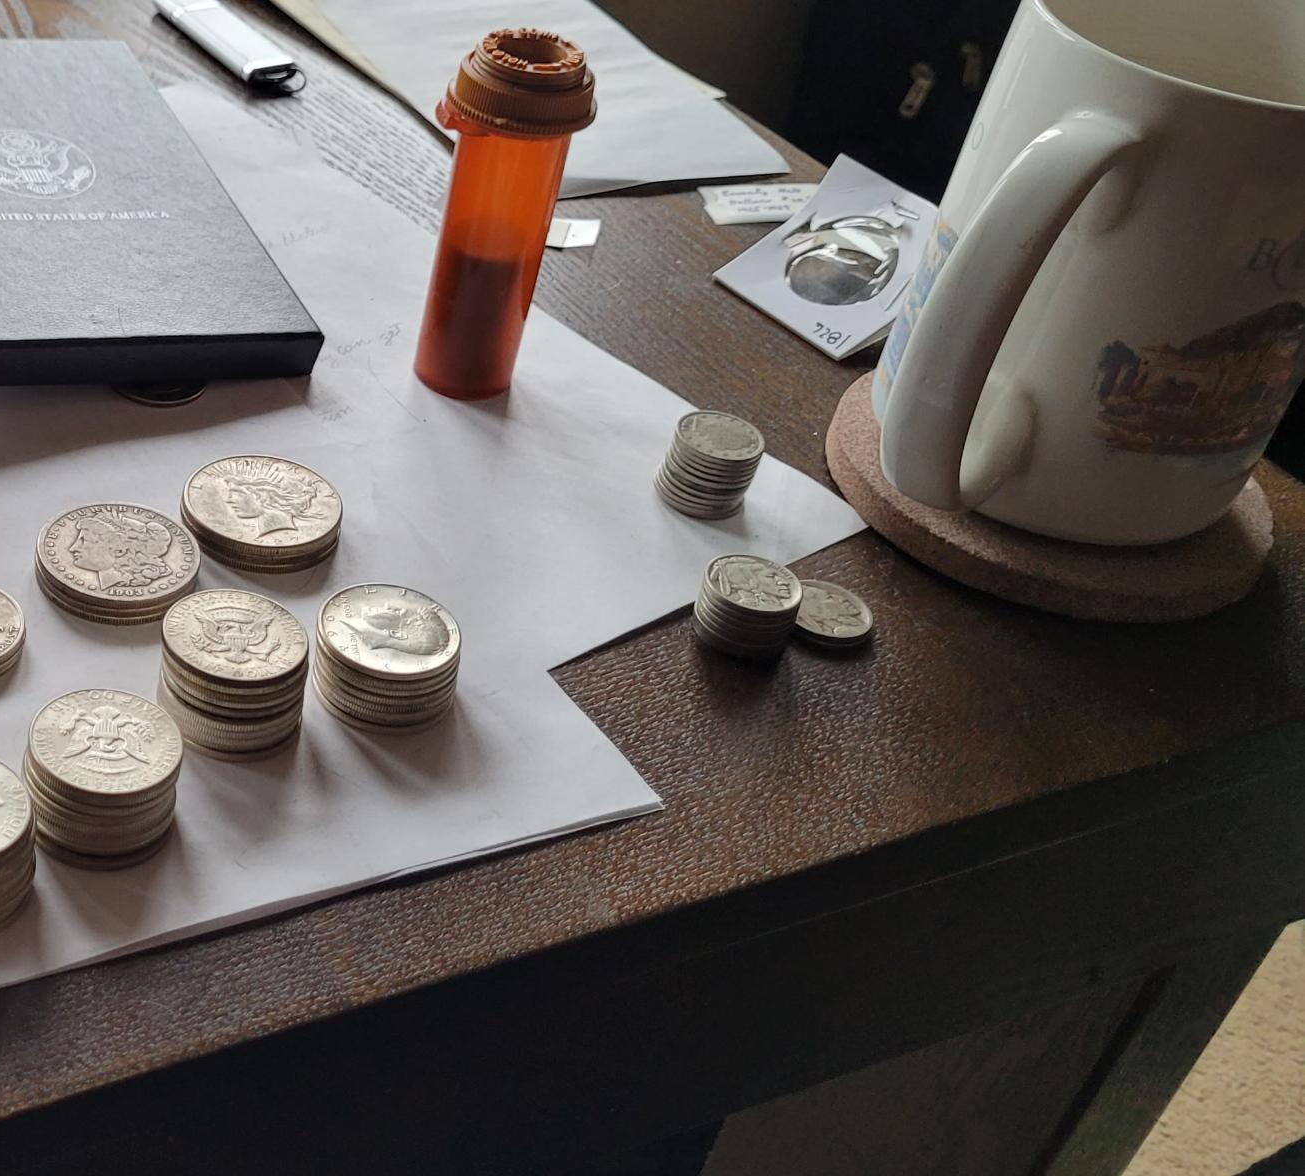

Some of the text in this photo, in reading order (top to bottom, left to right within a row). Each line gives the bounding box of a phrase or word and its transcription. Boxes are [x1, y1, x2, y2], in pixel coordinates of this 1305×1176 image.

[36, 212, 86, 221] STATES
[88, 212, 106, 221] OF
[110, 211, 170, 220] AMERICA
